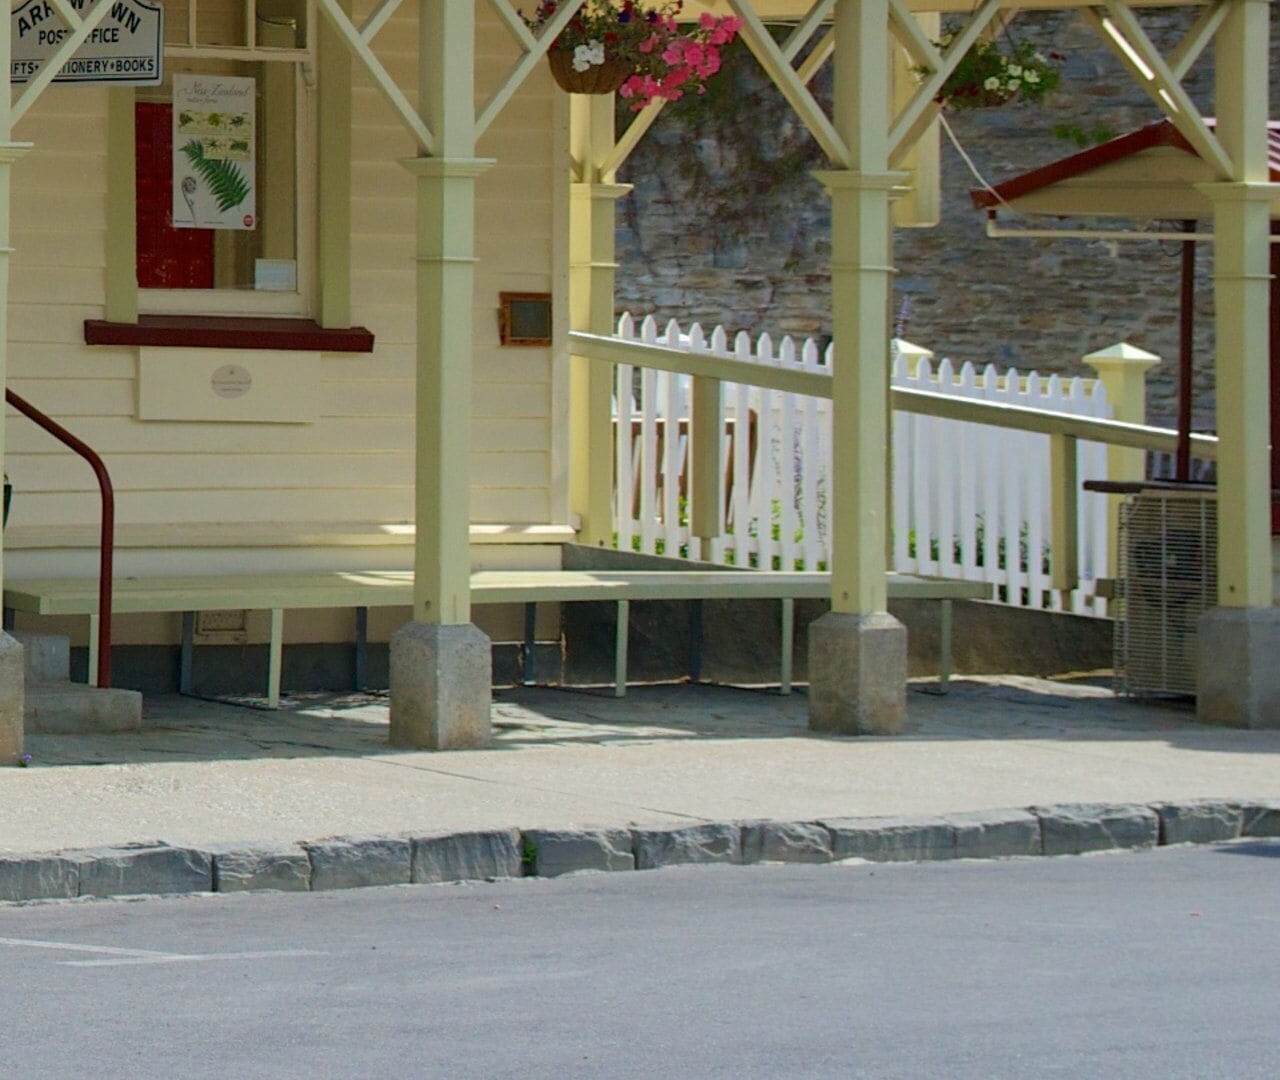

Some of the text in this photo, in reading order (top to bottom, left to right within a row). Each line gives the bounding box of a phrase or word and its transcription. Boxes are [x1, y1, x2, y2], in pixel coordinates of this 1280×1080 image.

[38, 28, 120, 46] POS FICE
[116, 59, 154, 72] BOOKS
